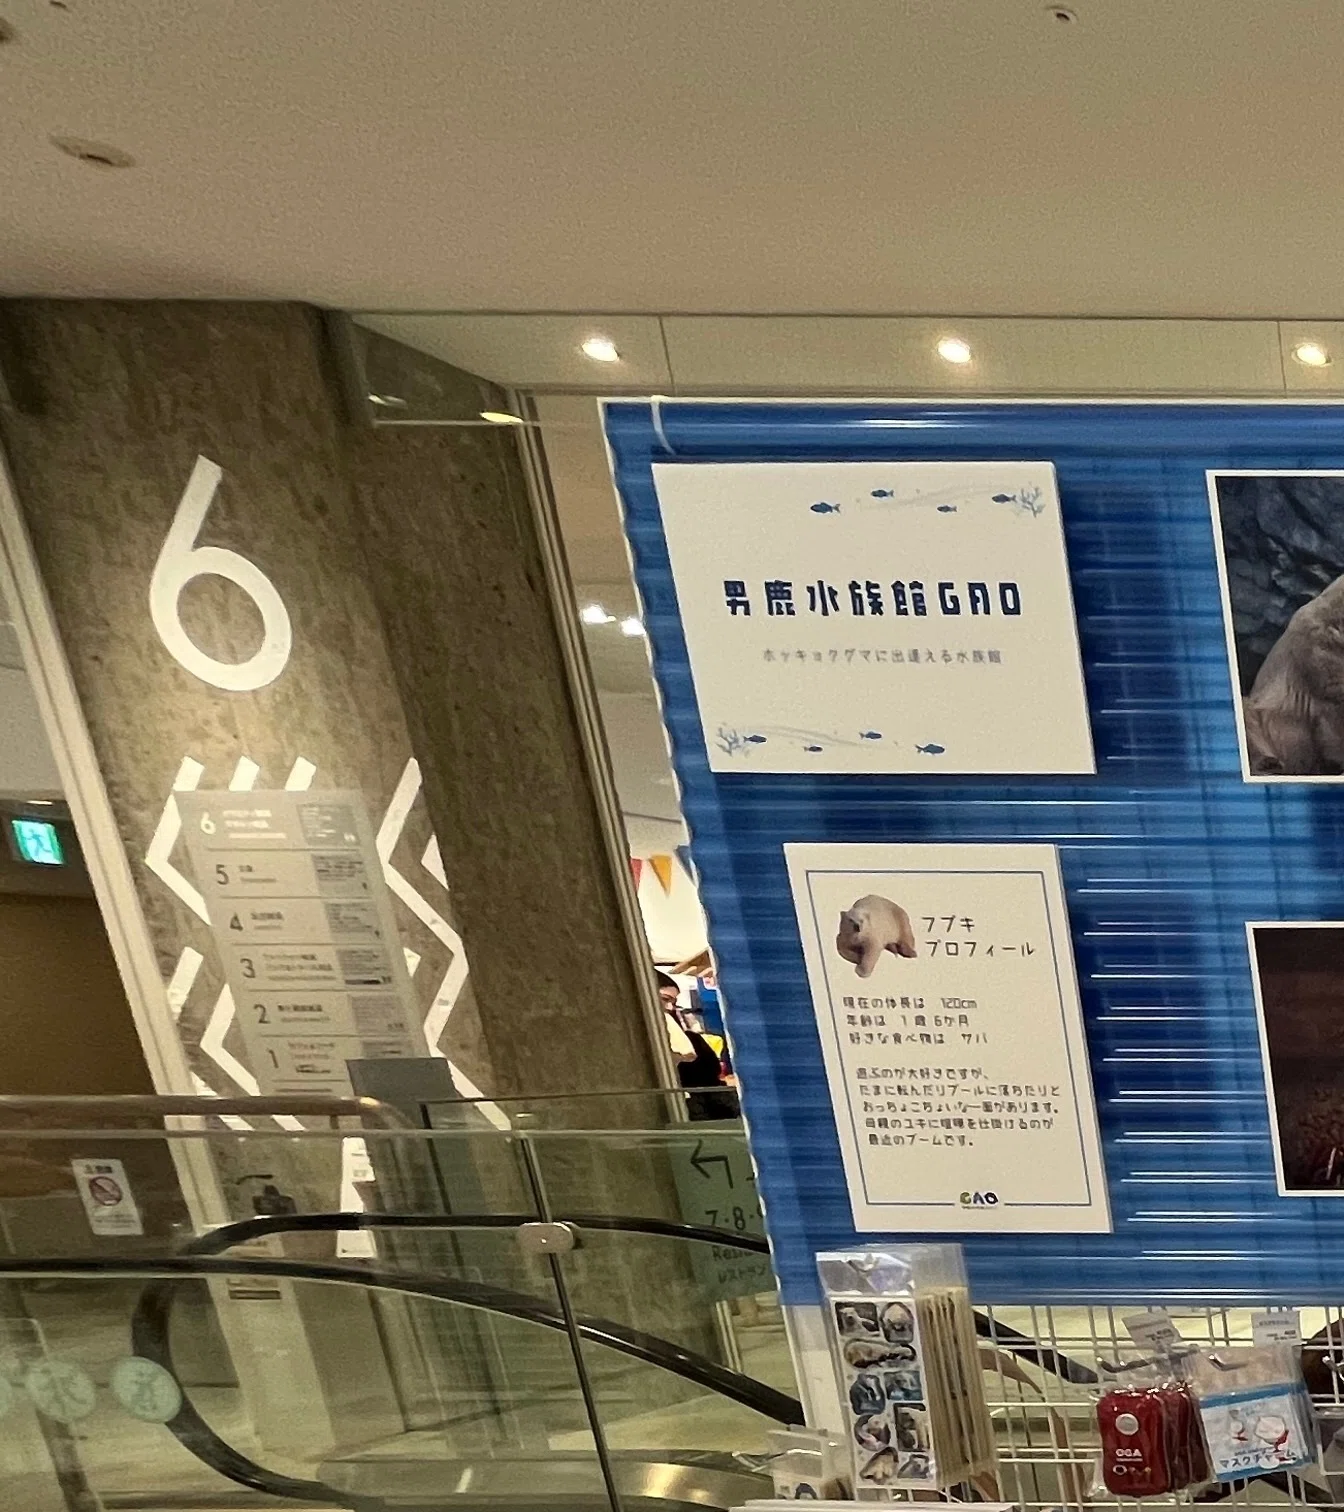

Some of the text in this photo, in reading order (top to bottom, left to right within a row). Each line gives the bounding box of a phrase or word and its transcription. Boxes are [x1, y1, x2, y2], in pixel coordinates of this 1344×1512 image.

[150, 454, 292, 692] 6
[723, 579, 1022, 617] 男鹿水族館GAO
[200, 811, 217, 835] 6
[215, 863, 230, 886] 5
[920, 915, 976, 933] フブキ
[924, 940, 1037, 958] プロフィール
[240, 957, 256, 979] 3
[253, 1003, 271, 1025] 2
[959, 1191, 999, 1205] GAO
